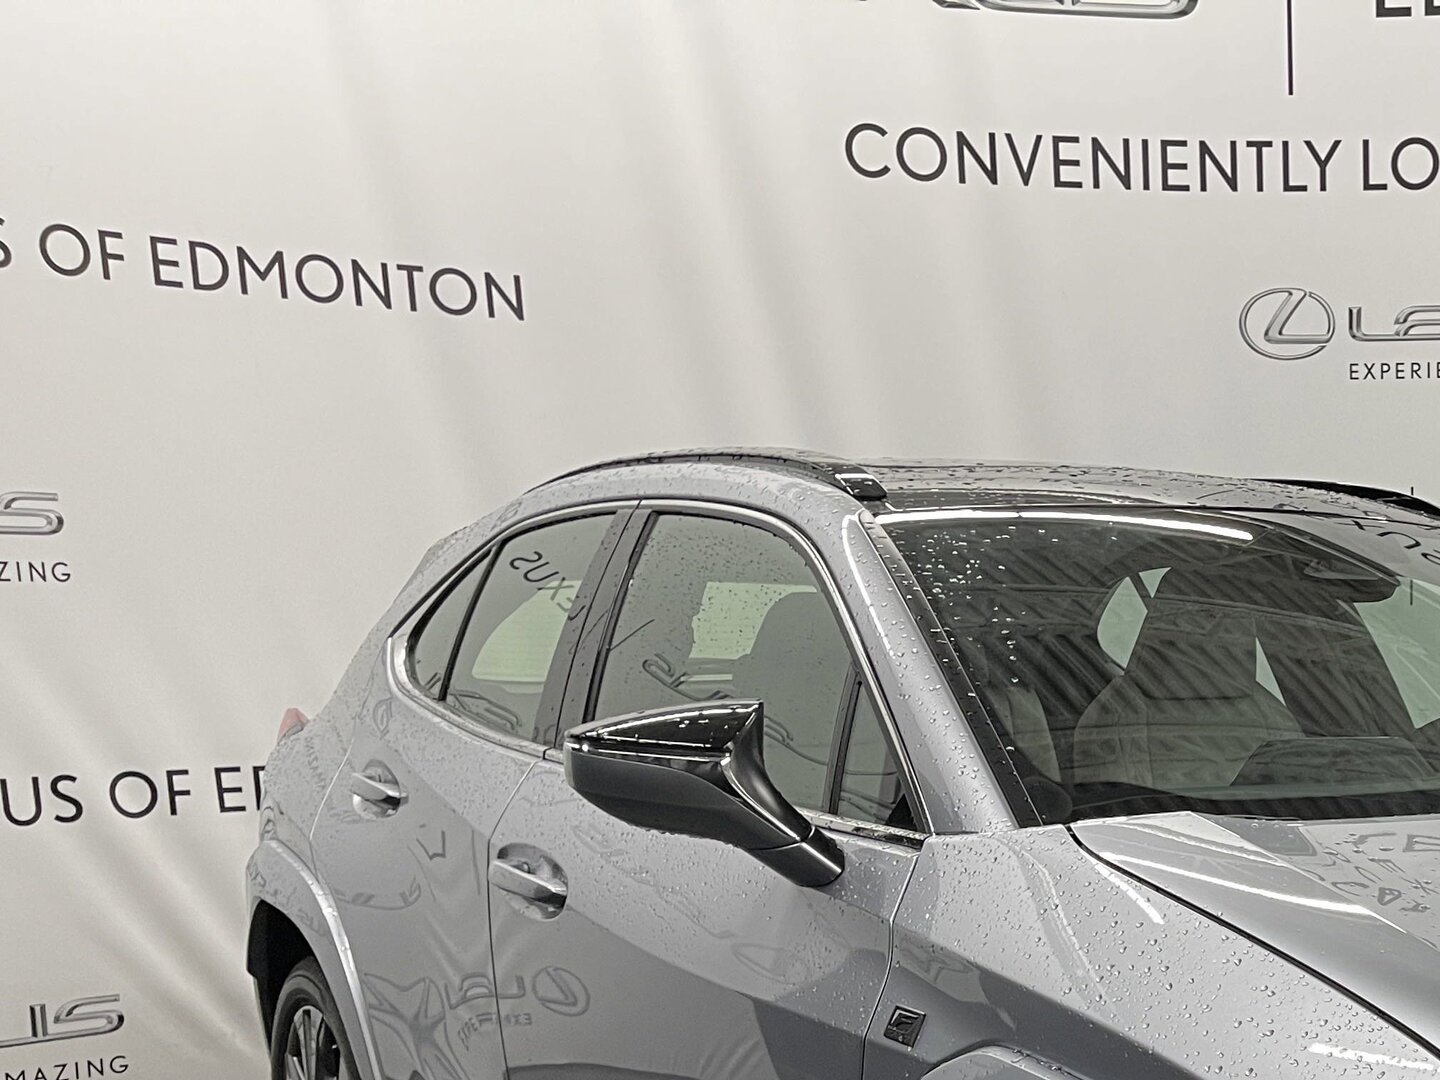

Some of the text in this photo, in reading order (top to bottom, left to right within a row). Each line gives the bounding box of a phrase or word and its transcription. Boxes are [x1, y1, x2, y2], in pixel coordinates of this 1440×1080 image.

[845, 123, 1342, 192] CONVENIENTLY
[39, 224, 124, 280] OF
[149, 236, 524, 321] EDMONTON
[109, 769, 191, 819] OF
